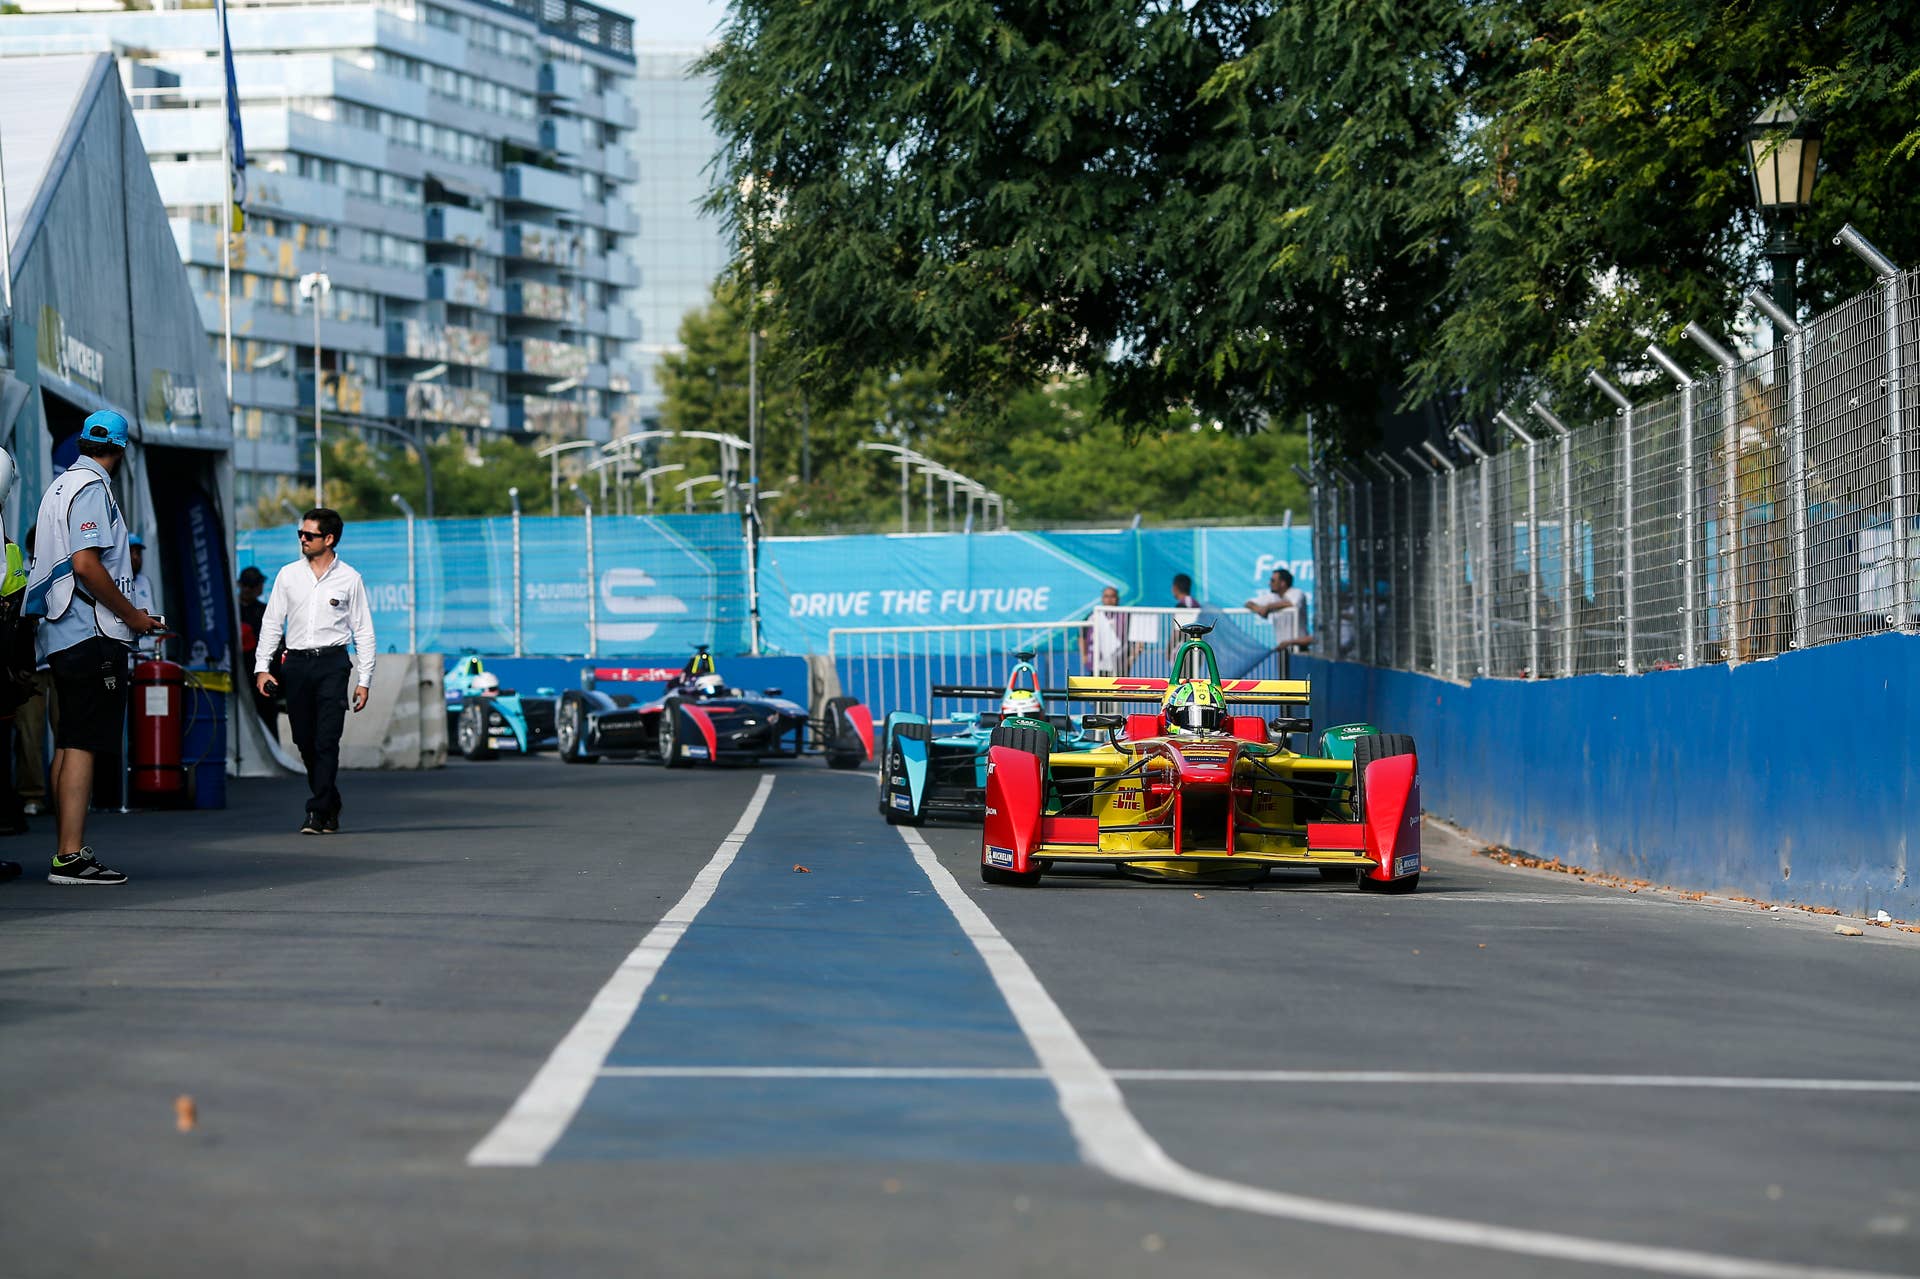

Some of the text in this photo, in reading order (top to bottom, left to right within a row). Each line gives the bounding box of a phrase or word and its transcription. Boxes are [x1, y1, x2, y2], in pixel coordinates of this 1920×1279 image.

[80, 521, 97, 531] ACA
[189, 503, 215, 631] MICHELIN
[789, 586, 1050, 617] DRIVE THE FUTURE
[992, 851, 1013, 862] MICHELIN
